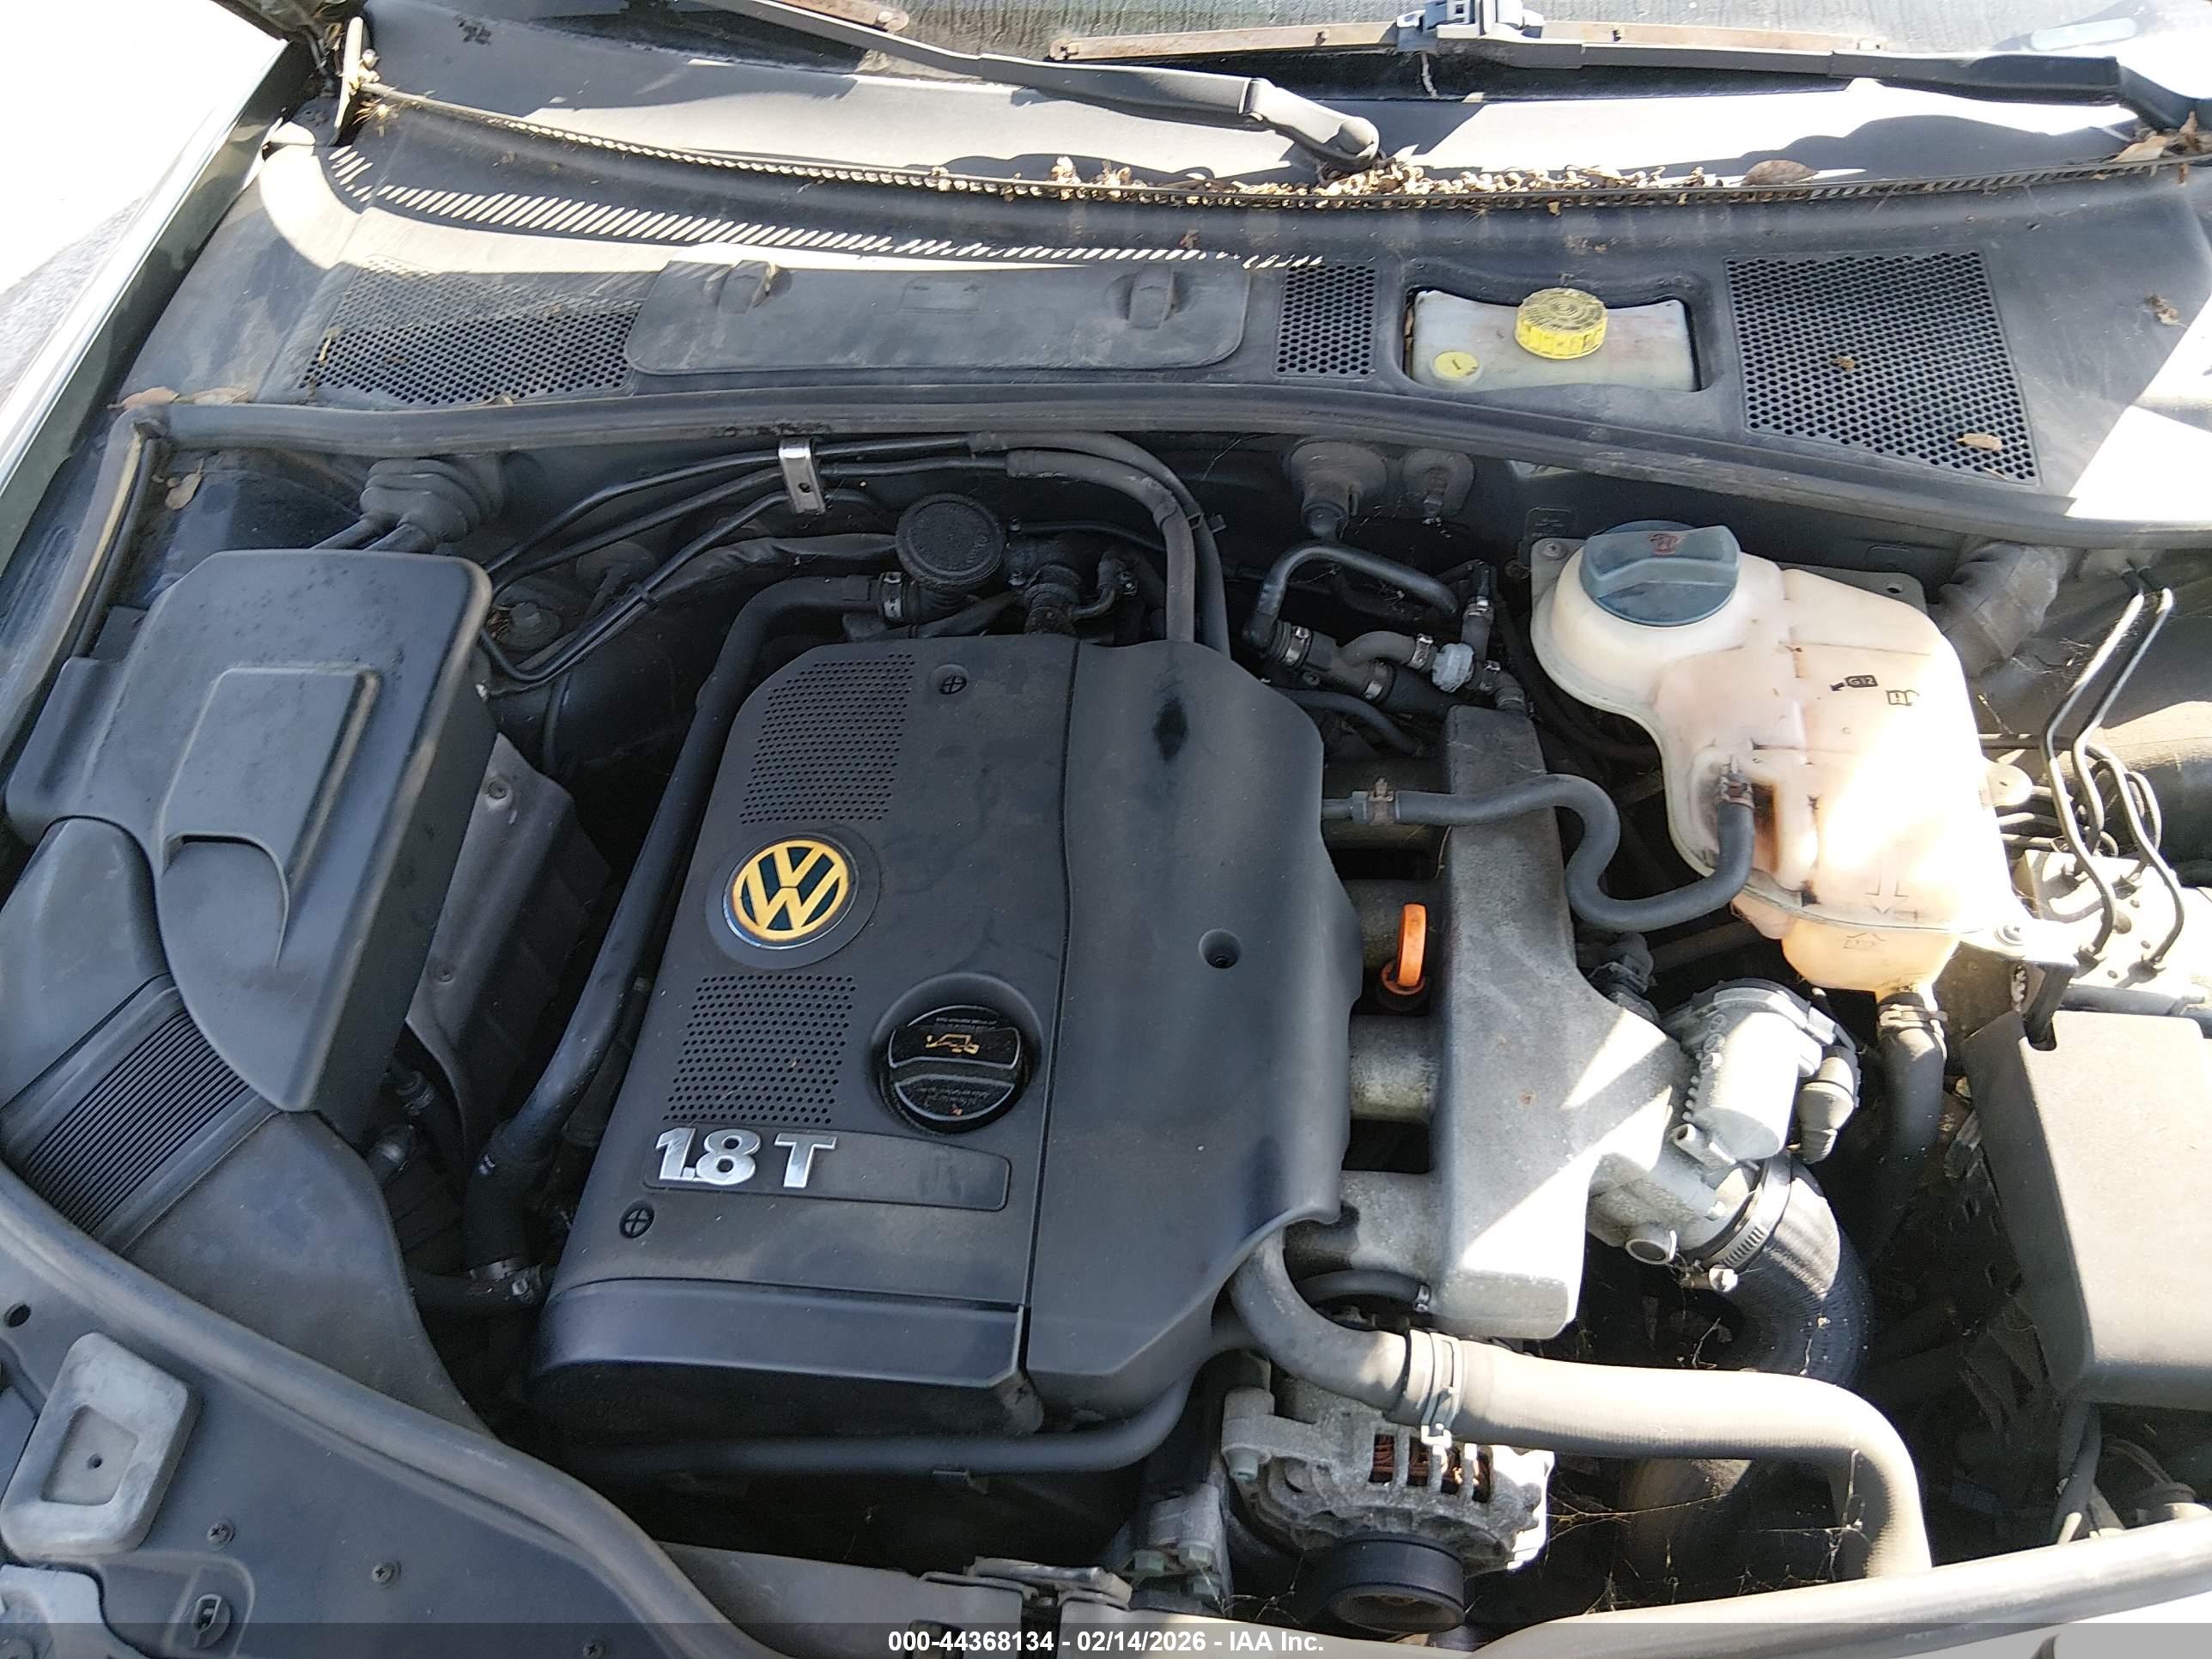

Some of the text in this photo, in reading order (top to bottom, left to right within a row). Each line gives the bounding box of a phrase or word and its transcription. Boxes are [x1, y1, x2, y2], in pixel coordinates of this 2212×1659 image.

[1846, 677, 1876, 686] G12
[732, 839, 849, 942] VW
[655, 1127, 837, 1188] 1.8 T
